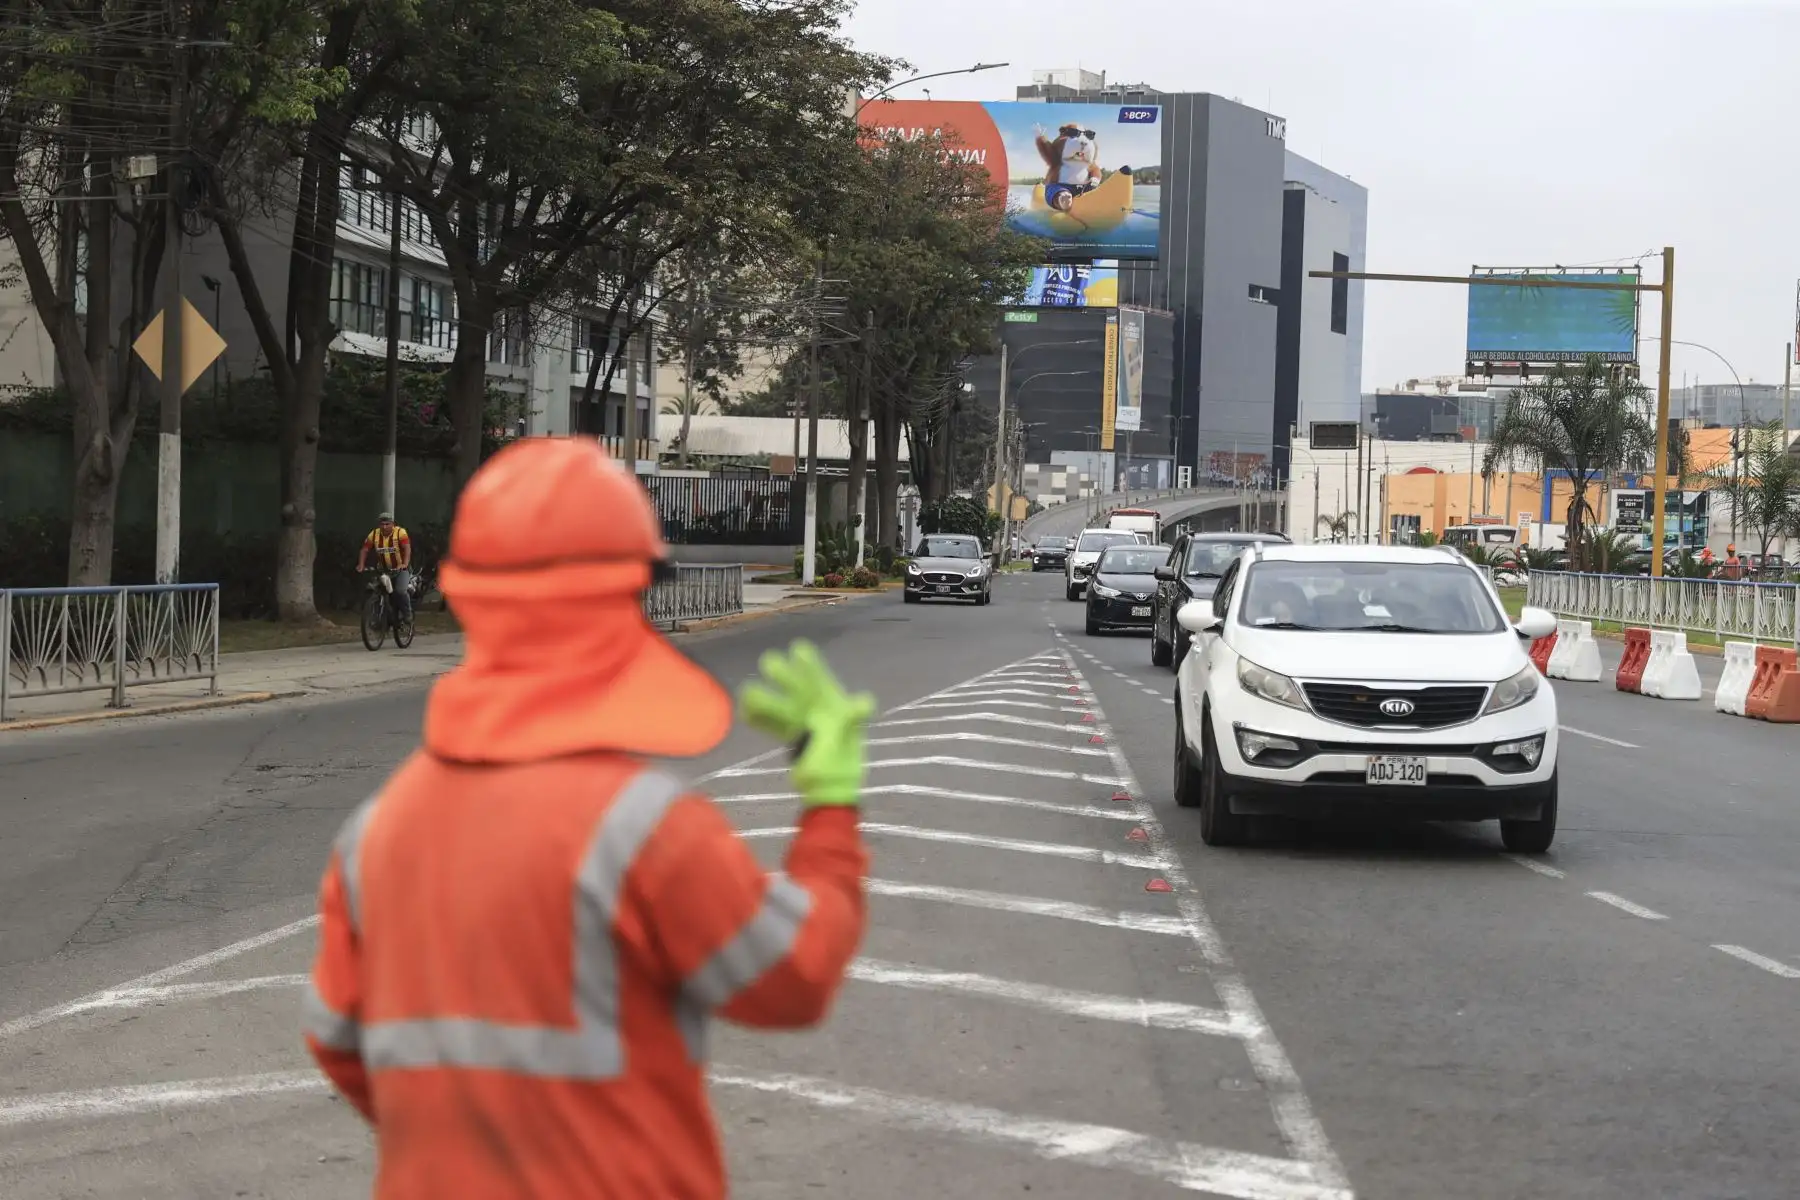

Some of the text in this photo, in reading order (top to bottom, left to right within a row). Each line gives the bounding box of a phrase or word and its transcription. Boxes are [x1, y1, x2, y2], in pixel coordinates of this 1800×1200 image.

[1129, 111, 1147, 120] BCP
[1489, 351, 1515, 361] BEBIDAS
[1561, 352, 1570, 361] EN
[1386, 703, 1409, 713] KIA
[1369, 763, 1424, 781] ADJ-120
